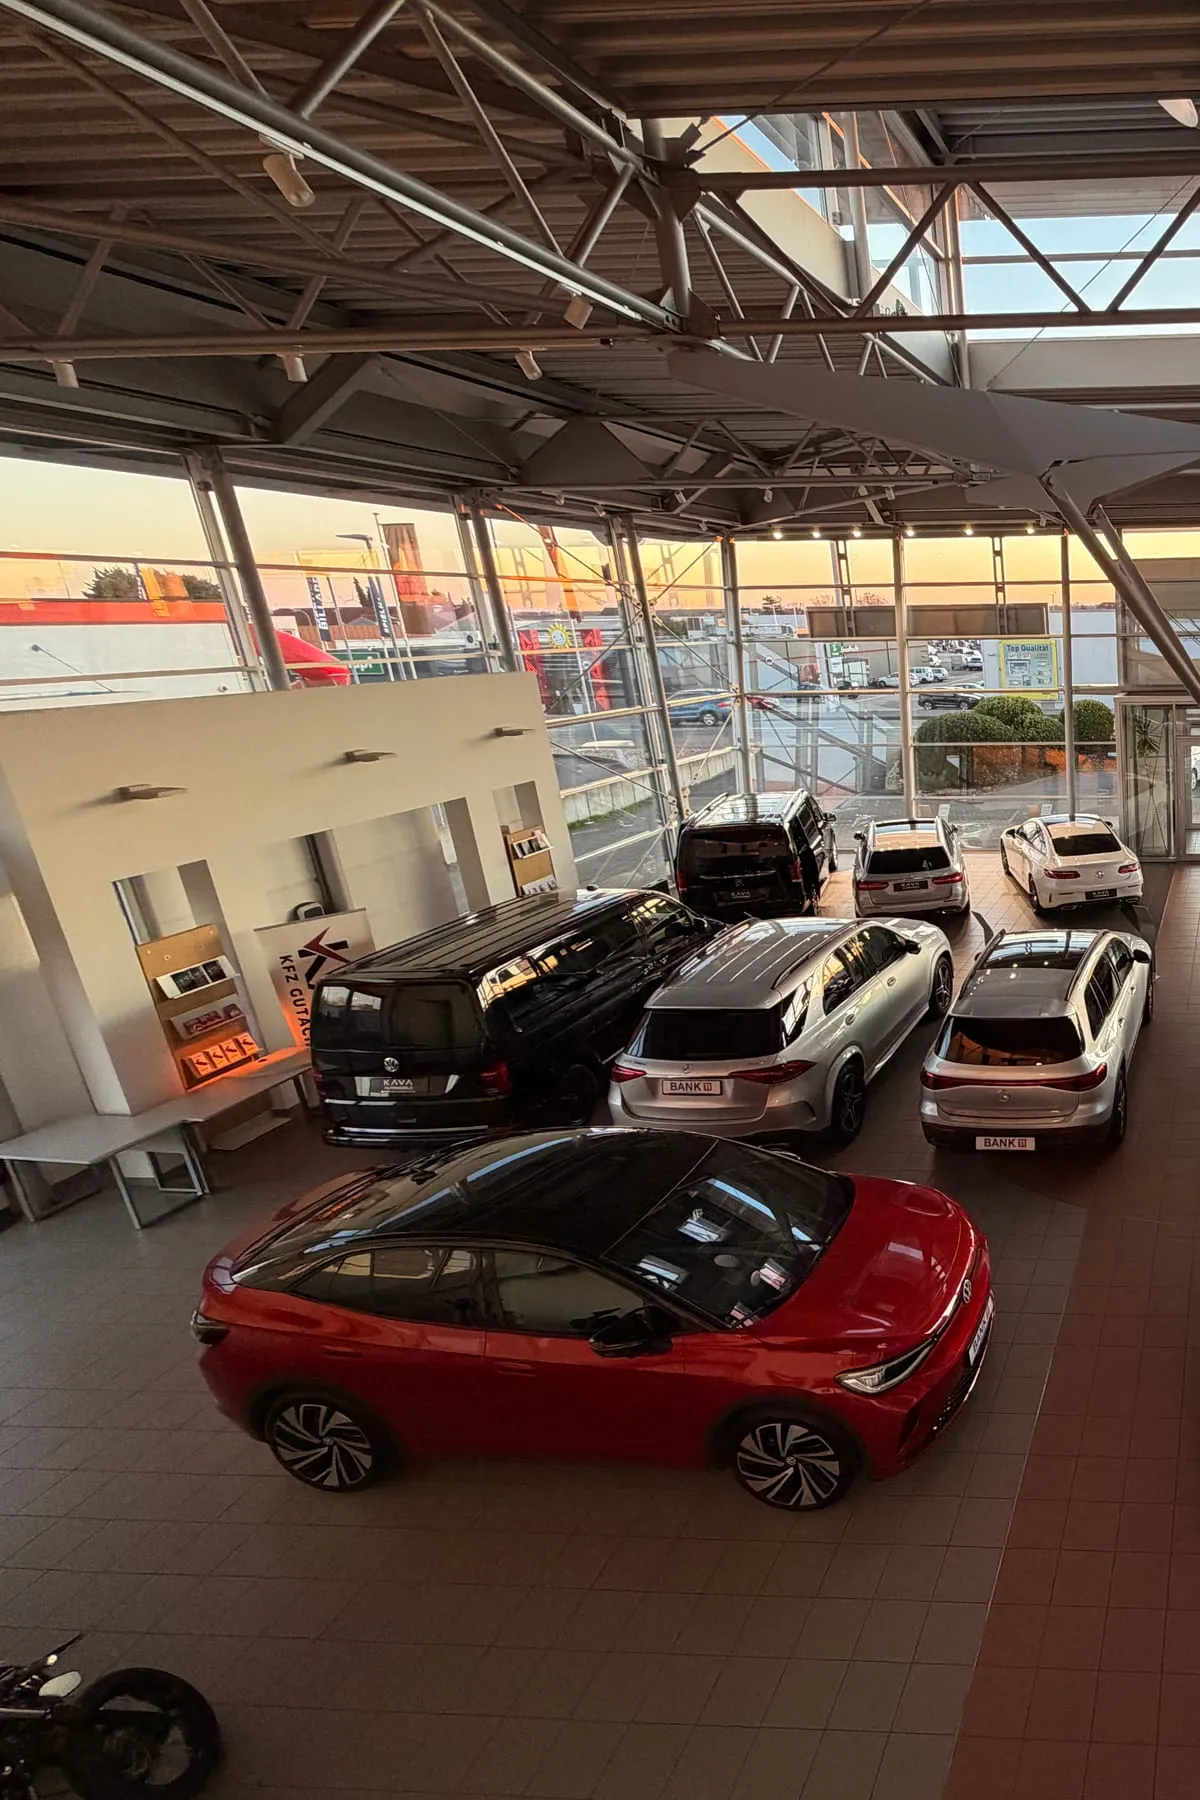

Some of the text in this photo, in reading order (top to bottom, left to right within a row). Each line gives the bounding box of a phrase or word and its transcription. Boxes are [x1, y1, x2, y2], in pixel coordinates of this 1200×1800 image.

[1006, 644, 1020, 653] Top
[279, 953, 313, 1047] KFZ GUTAC
[670, 1082, 701, 1092] BANK
[984, 1138, 1016, 1148] BANK
